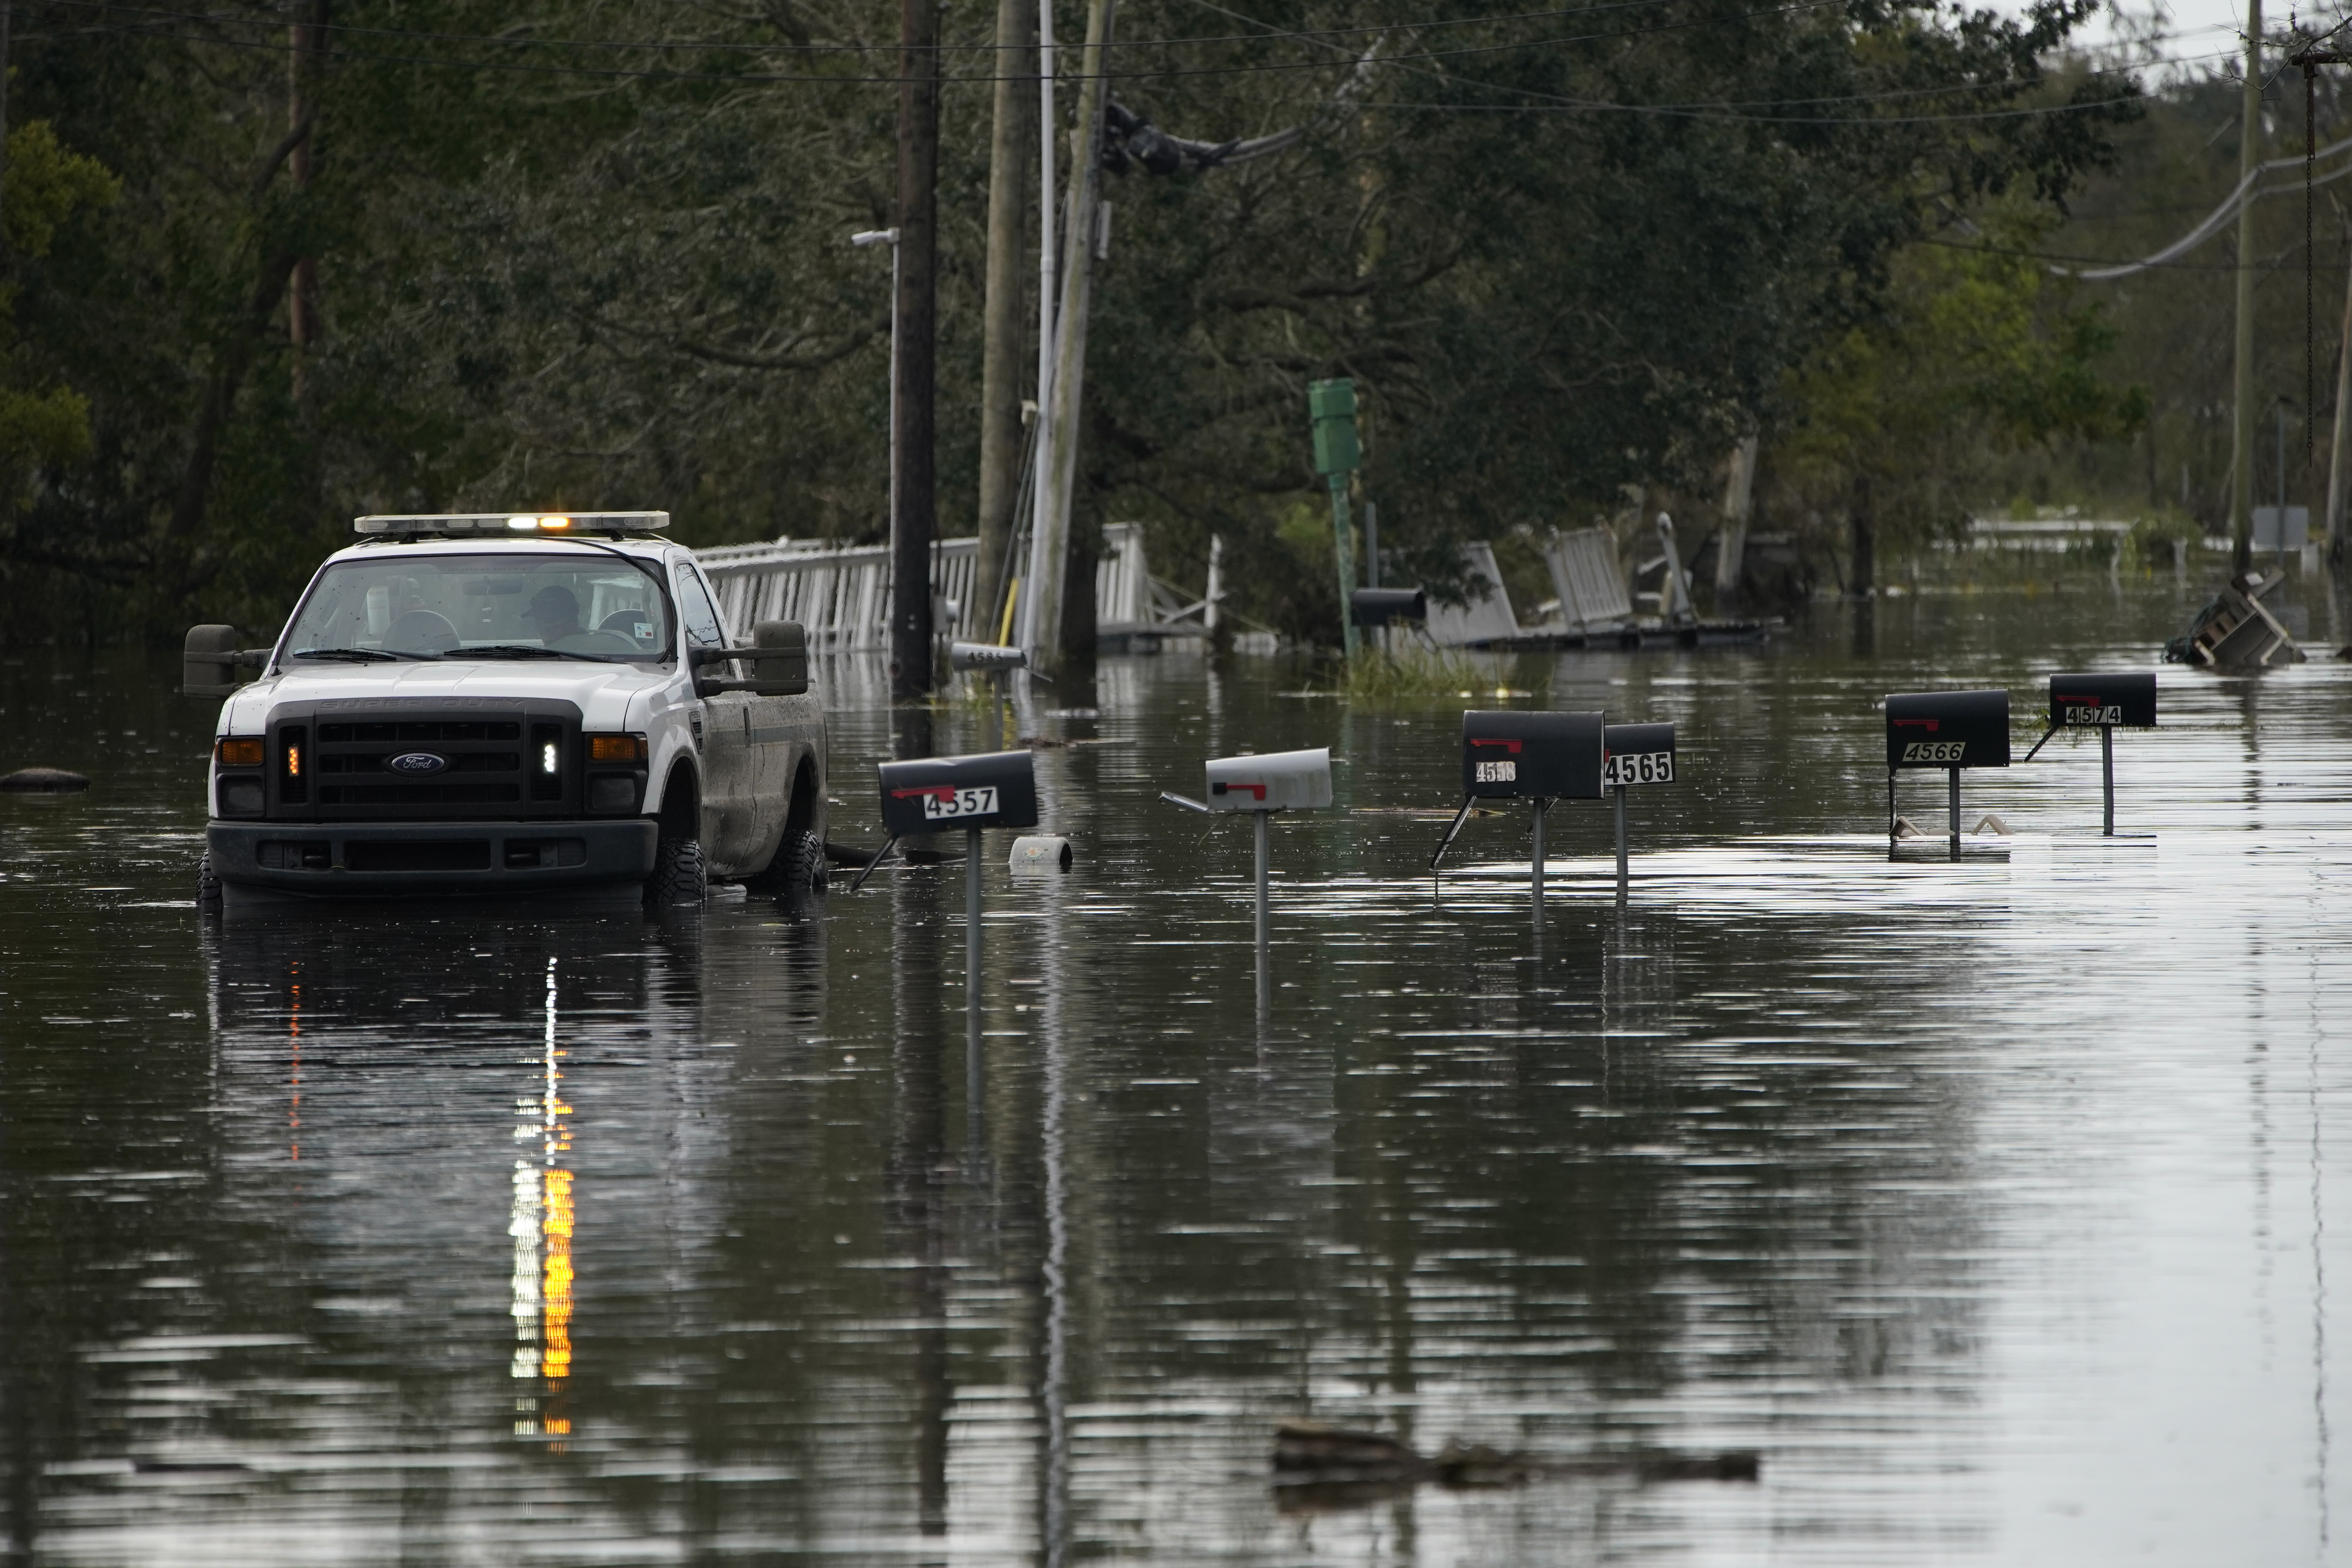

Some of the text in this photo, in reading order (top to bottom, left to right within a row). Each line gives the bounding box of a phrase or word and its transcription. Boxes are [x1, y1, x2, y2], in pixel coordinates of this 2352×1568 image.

[320, 698, 523, 709] SUPER DUTY
[2067, 707, 2120, 723] 4574
[1906, 744, 1962, 760] 4566
[403, 756, 431, 769] Ford
[1606, 753, 1670, 783] 4565
[1476, 762, 1516, 782] 4558
[926, 789, 993, 816] 4557
